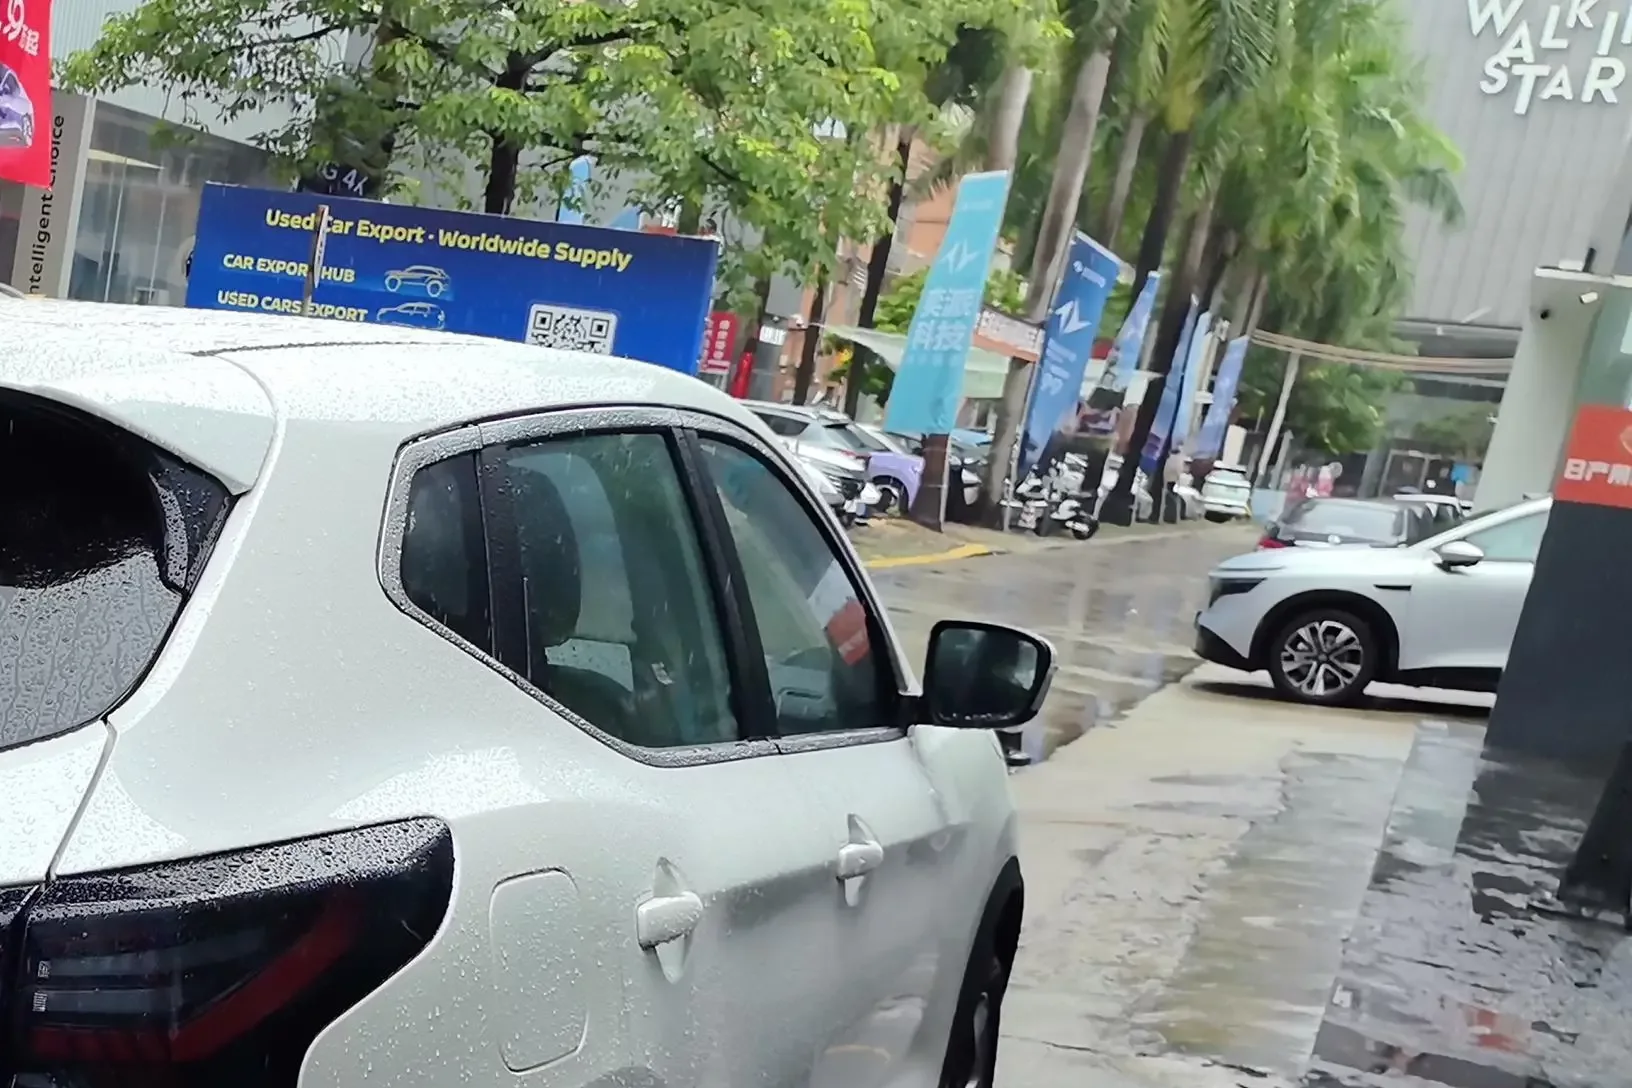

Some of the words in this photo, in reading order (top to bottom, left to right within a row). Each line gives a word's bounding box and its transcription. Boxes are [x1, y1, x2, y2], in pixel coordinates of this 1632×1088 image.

[1468, 0, 1632, 63] WALKI
[1479, 55, 1626, 115] STAR
[29, 193, 54, 294] ntelligent
[223, 253, 255, 270] CAR
[256, 257, 311, 278] EXPOR
[321, 265, 356, 283] HUB
[266, 208, 316, 231] Used
[356, 219, 426, 243] Export
[438, 228, 550, 259] Worldwide
[554, 242, 633, 272] Supply
[217, 290, 259, 309] USED
[260, 296, 302, 314] CARS
[306, 301, 368, 321] EXPORT
